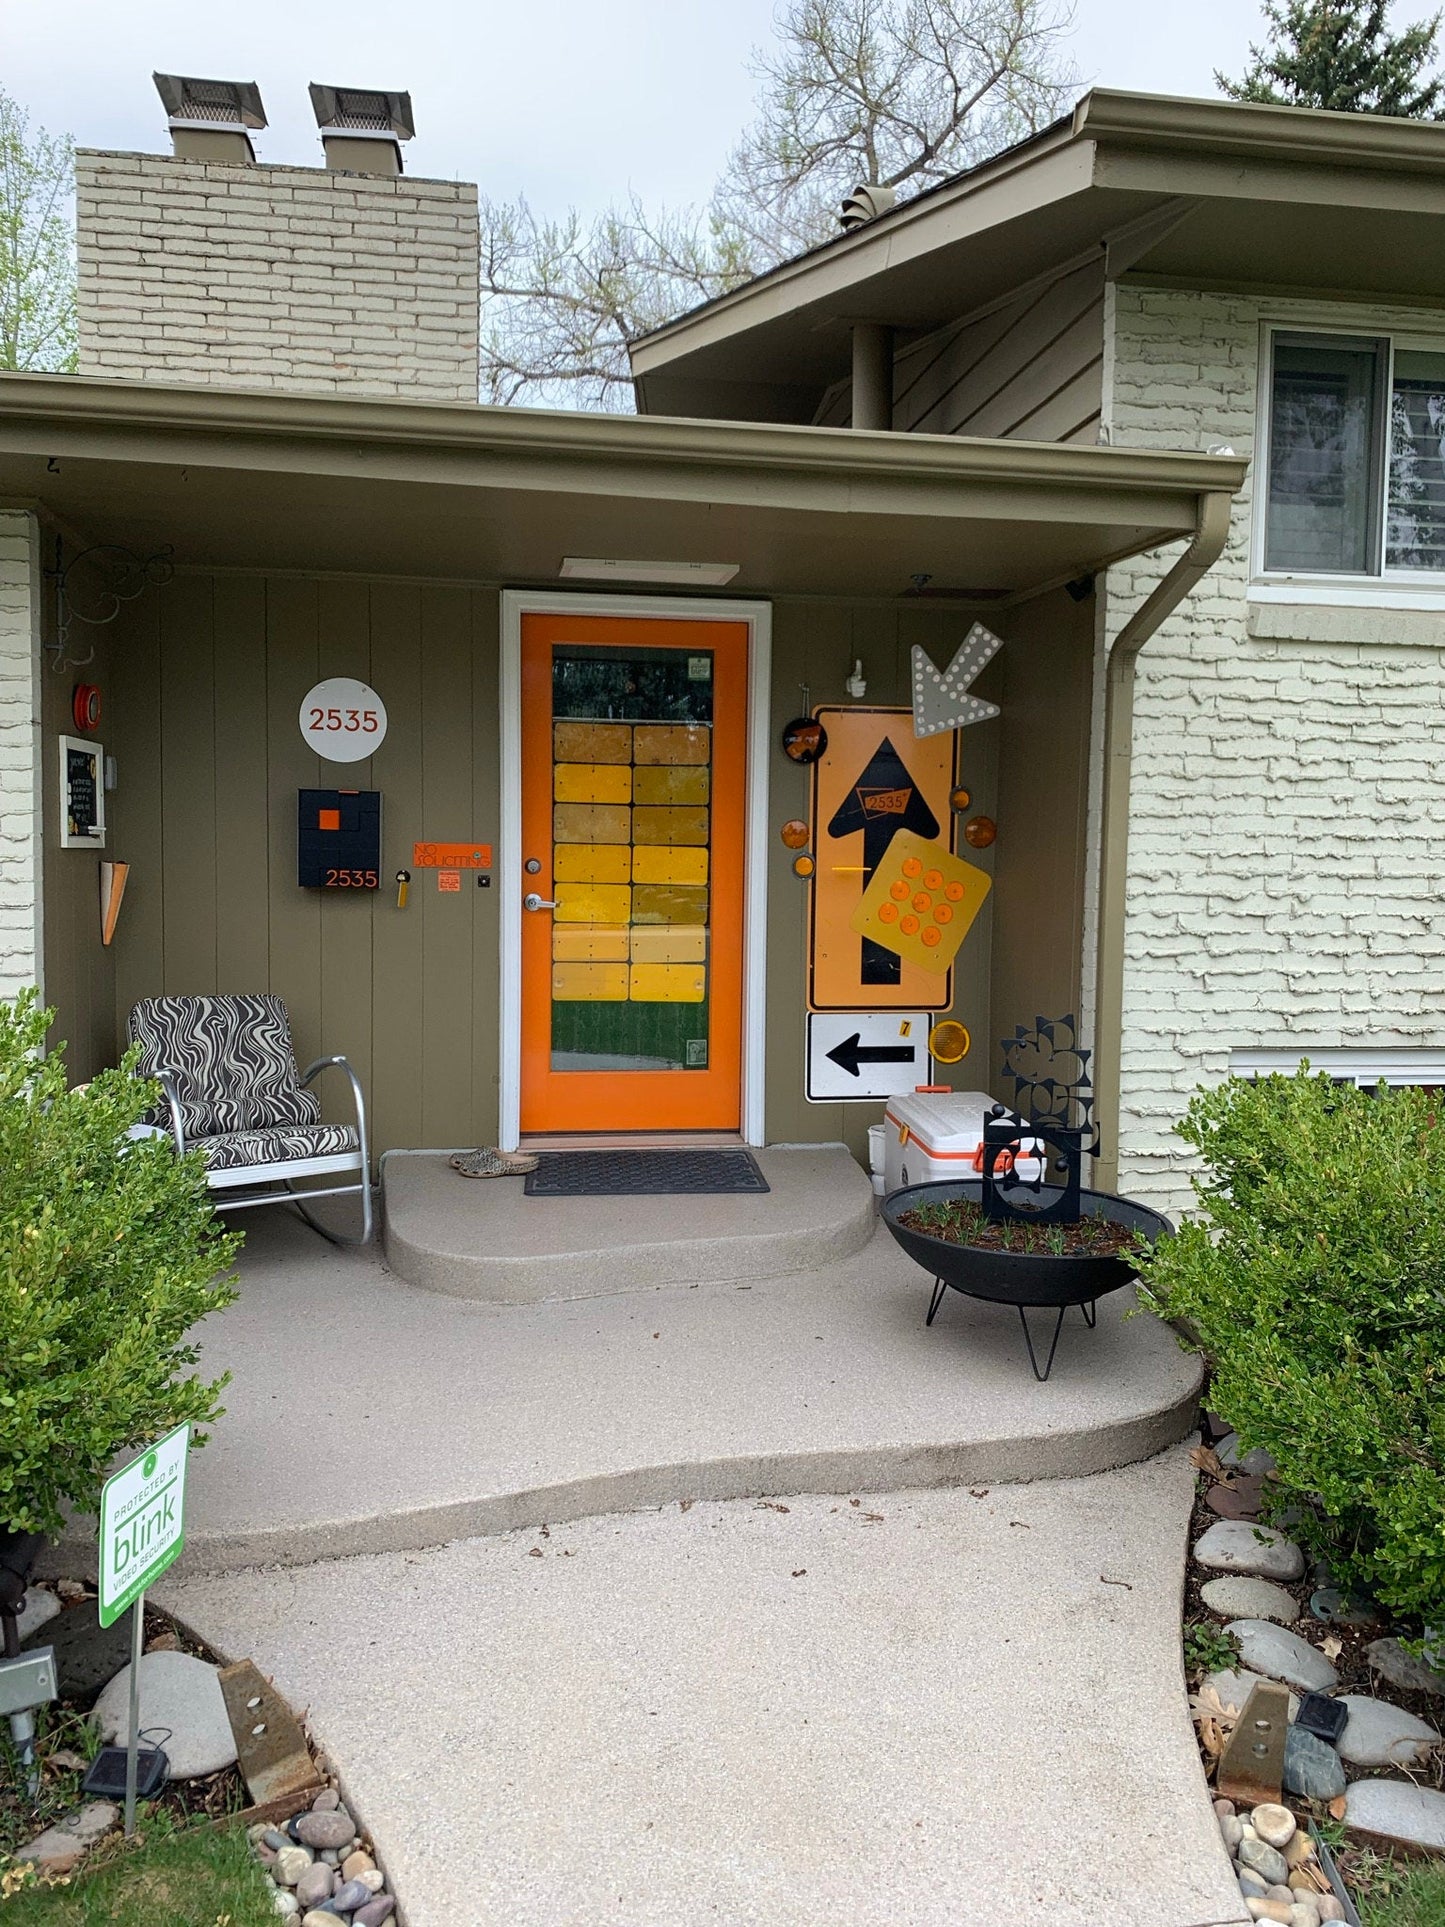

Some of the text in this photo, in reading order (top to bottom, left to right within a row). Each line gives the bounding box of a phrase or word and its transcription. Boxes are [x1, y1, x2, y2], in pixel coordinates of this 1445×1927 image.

[309, 708, 378, 732] 2535
[869, 796, 902, 808] 2535
[415, 844, 437, 855] NO
[415, 855, 491, 866] SOLICITING
[326, 870, 377, 887] 2535
[903, 1021, 910, 1035] 7
[114, 1460, 179, 1522] PROTECTED BY
[114, 1493, 175, 1575] blink
[113, 1527, 175, 1591] VIDEO SECURITY
